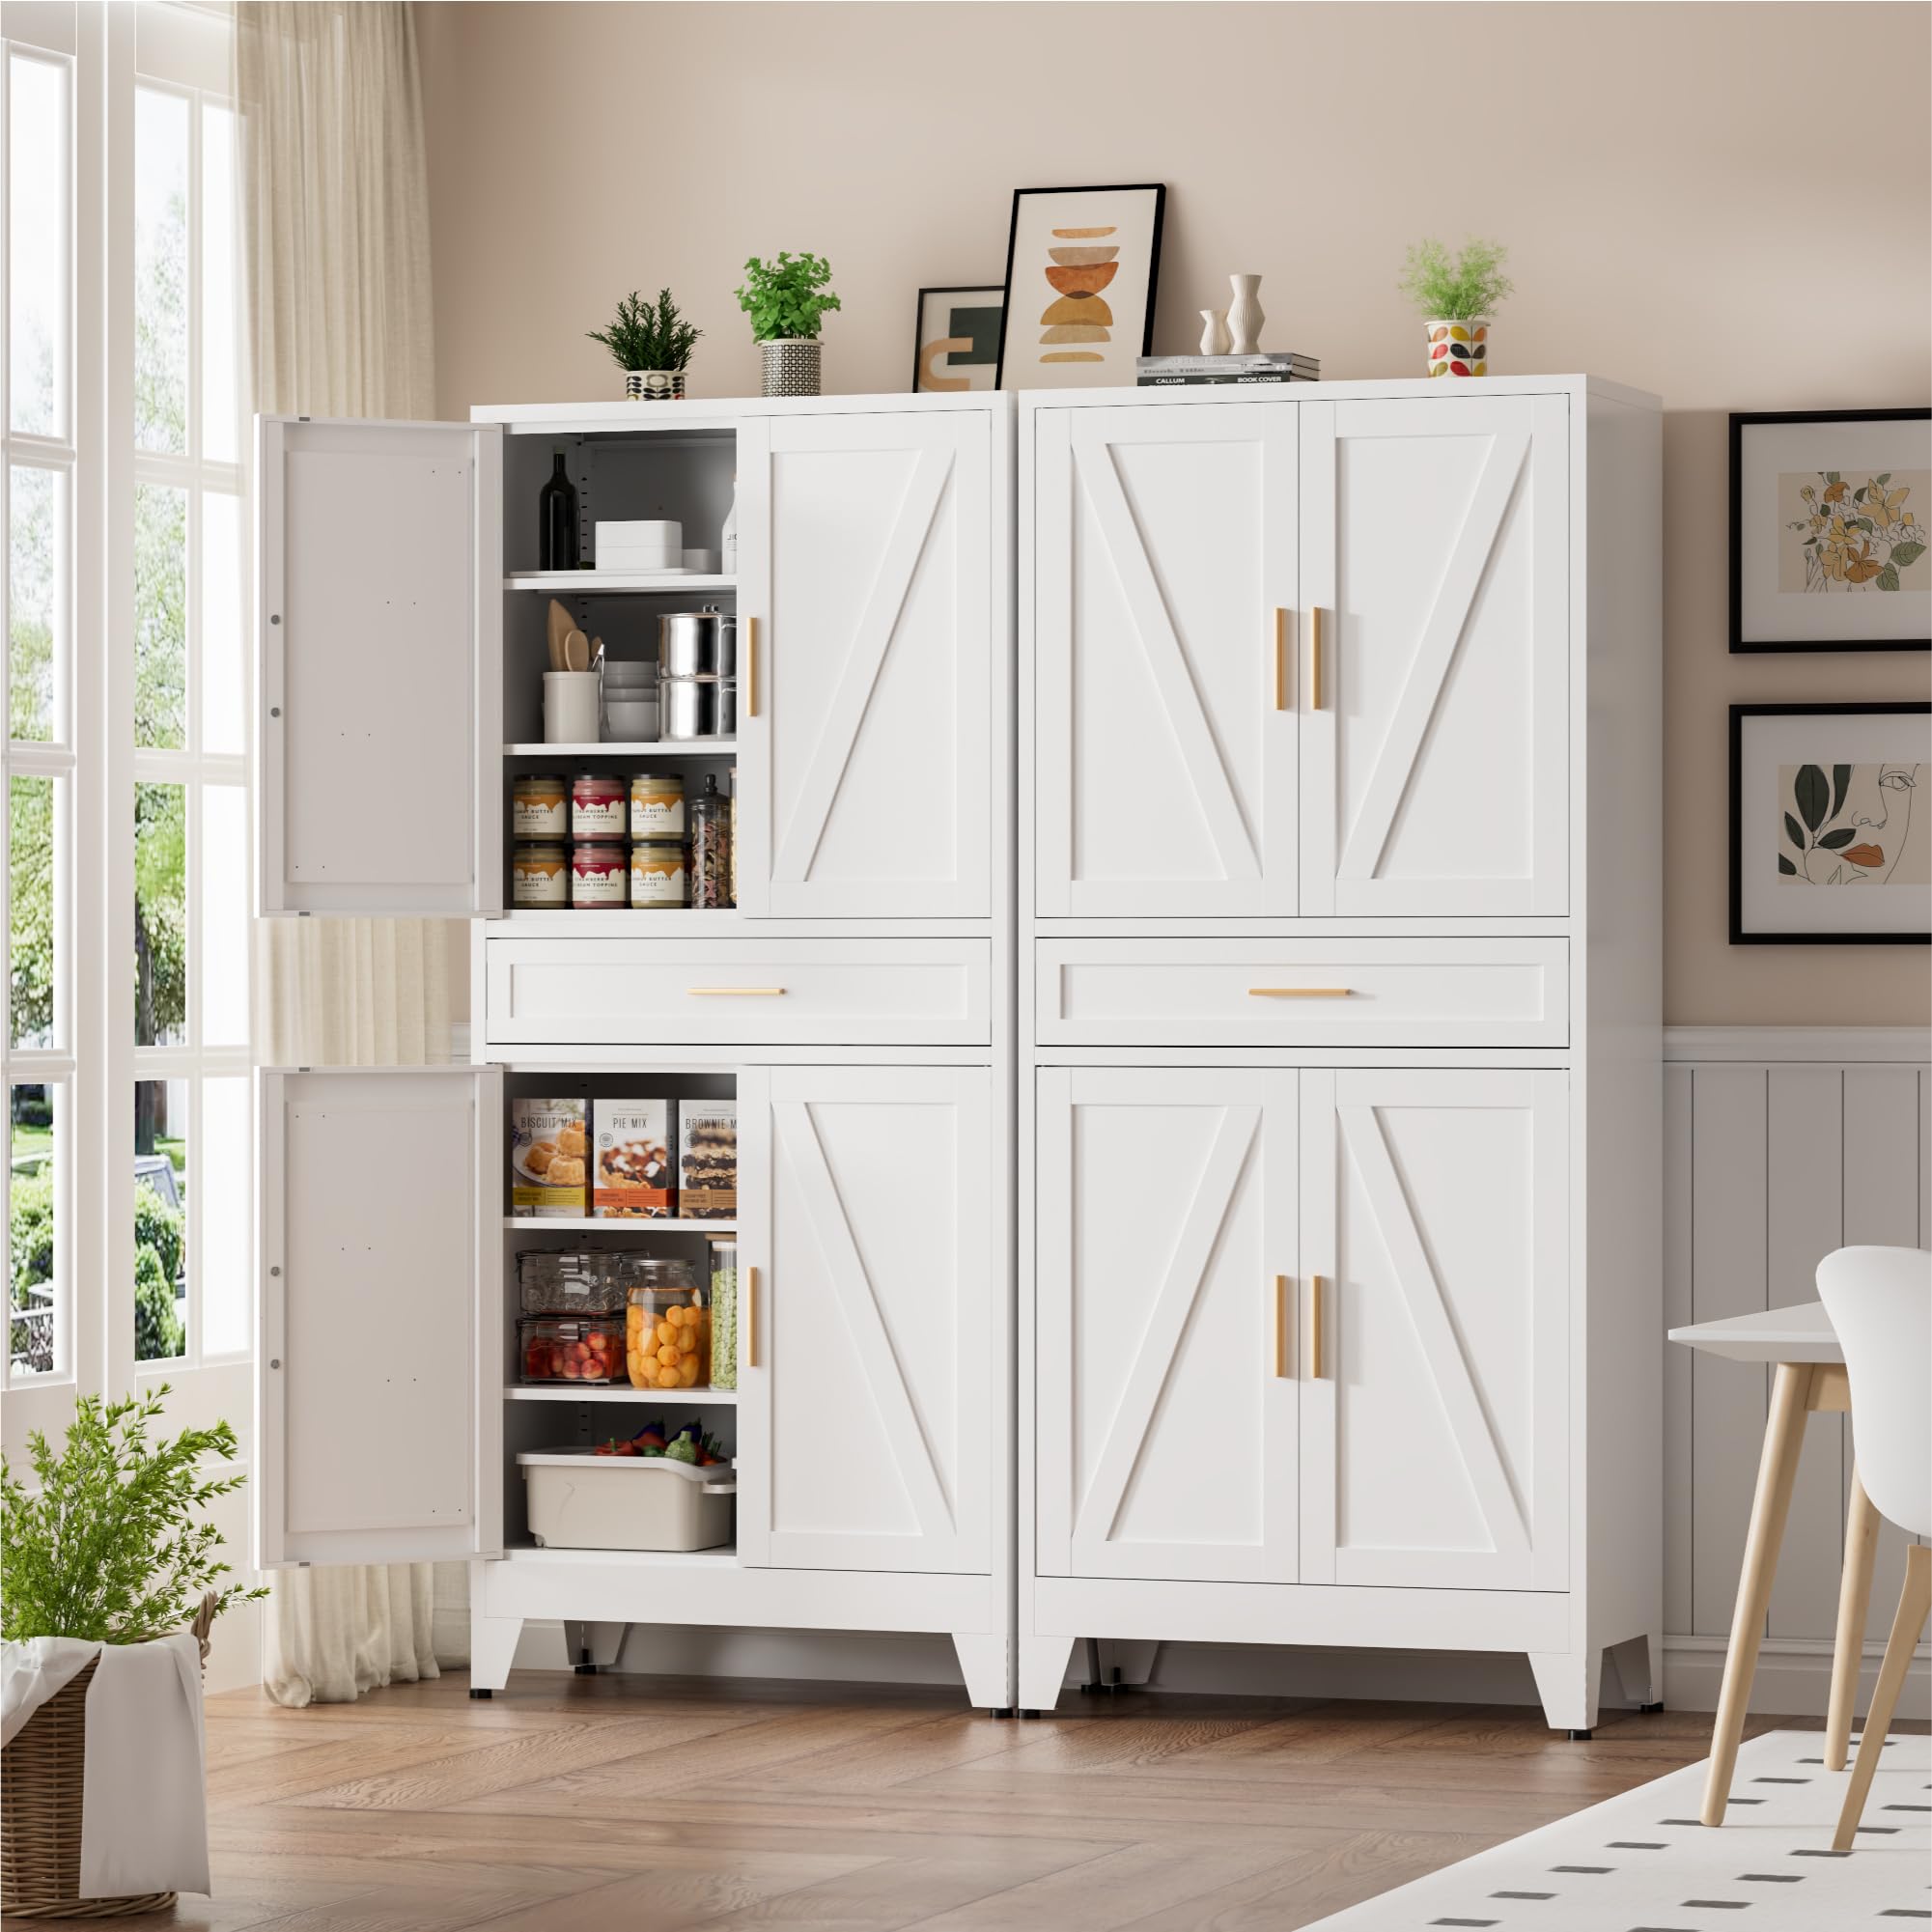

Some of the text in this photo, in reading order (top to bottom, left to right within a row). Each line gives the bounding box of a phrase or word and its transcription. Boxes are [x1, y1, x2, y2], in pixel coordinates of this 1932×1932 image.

[520, 1117, 577, 1128] BISCUIT MIX
[613, 1117, 647, 1129] PIE MIX
[685, 1118, 726, 1129] BROWNIE
